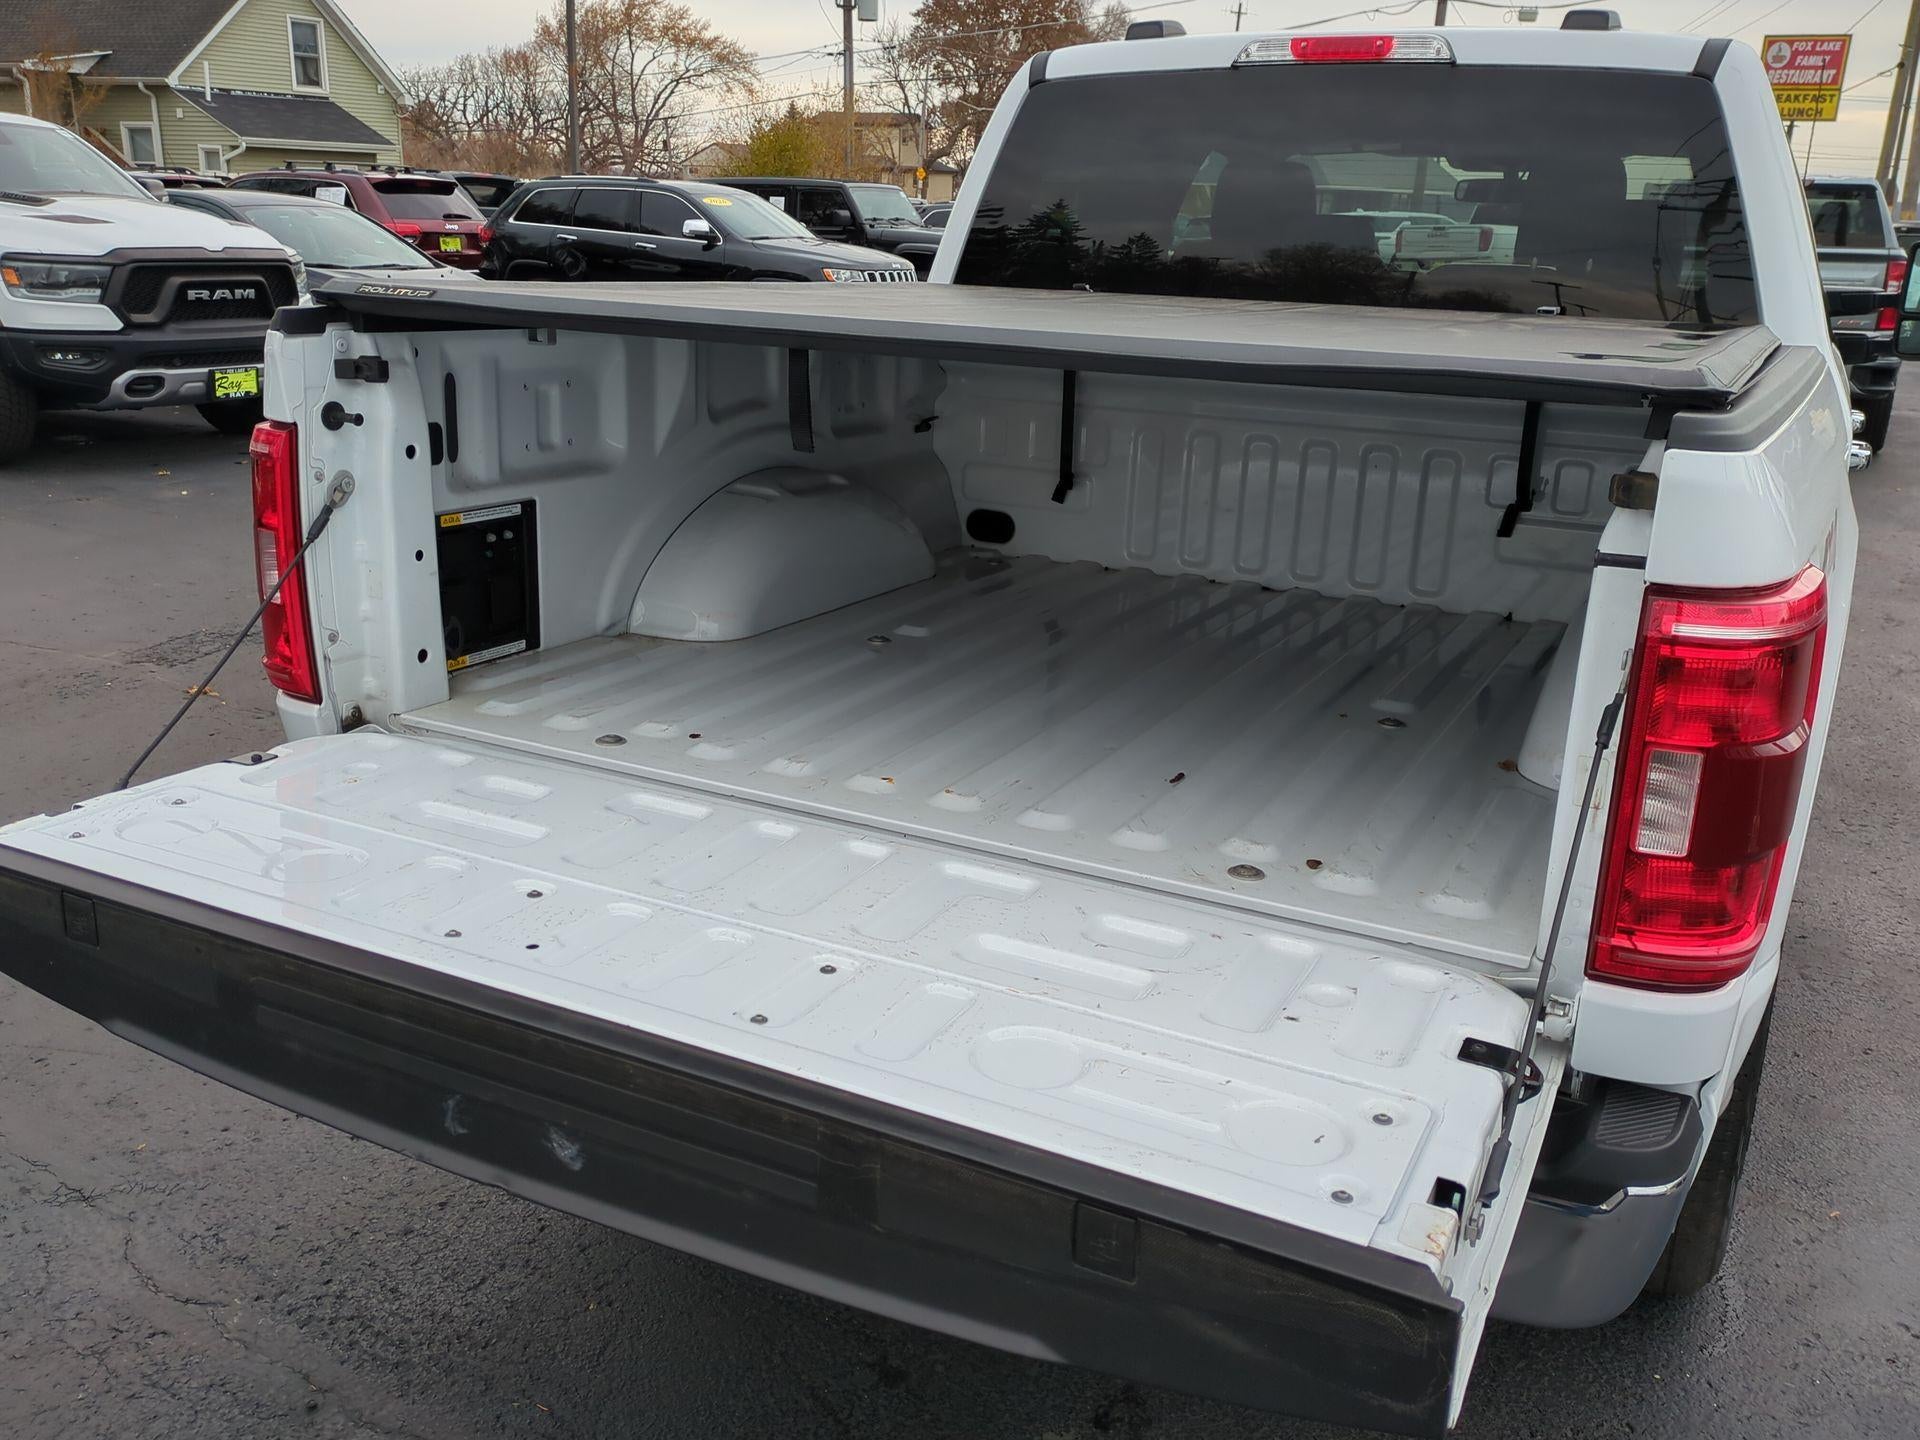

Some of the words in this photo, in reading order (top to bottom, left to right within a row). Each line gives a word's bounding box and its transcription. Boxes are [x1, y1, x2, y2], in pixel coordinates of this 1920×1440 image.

[1792, 41, 1814, 51] FOX
[1815, 41, 1843, 51] LAKE
[1794, 55, 1831, 66] FAMILY
[1767, 69, 1837, 84] RESTAURANT
[1776, 93, 1837, 104] EAKFAST
[1780, 107, 1824, 118] LUNCH
[187, 288, 256, 301] RAM
[358, 285, 434, 297] ROLLITUP
[215, 376, 243, 392] Ray
